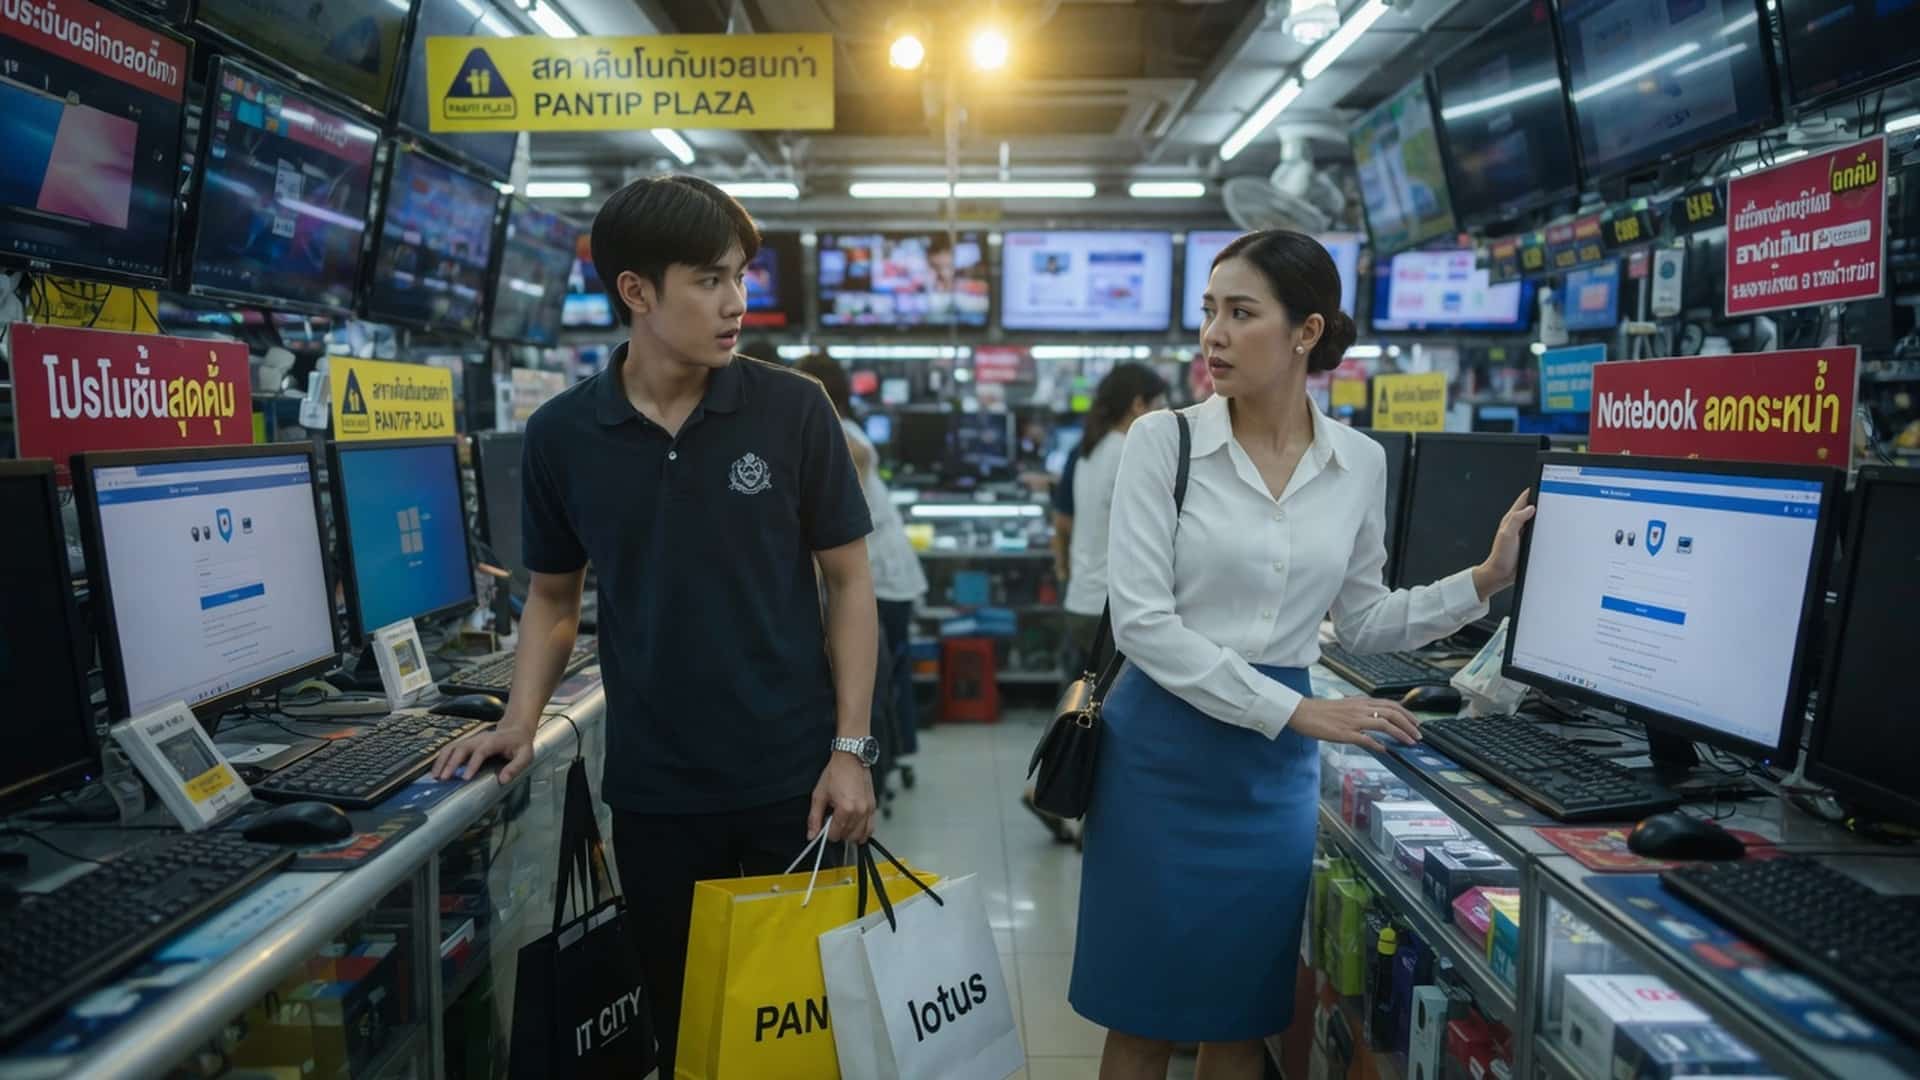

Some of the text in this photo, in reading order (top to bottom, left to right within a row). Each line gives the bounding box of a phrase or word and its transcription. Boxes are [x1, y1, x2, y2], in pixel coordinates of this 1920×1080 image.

[534, 91, 756, 117] PANTIP PLAZA
[1597, 387, 1699, 431] Notebook
[576, 985, 642, 1057] IT CITY
[907, 972, 987, 1043] lotus
